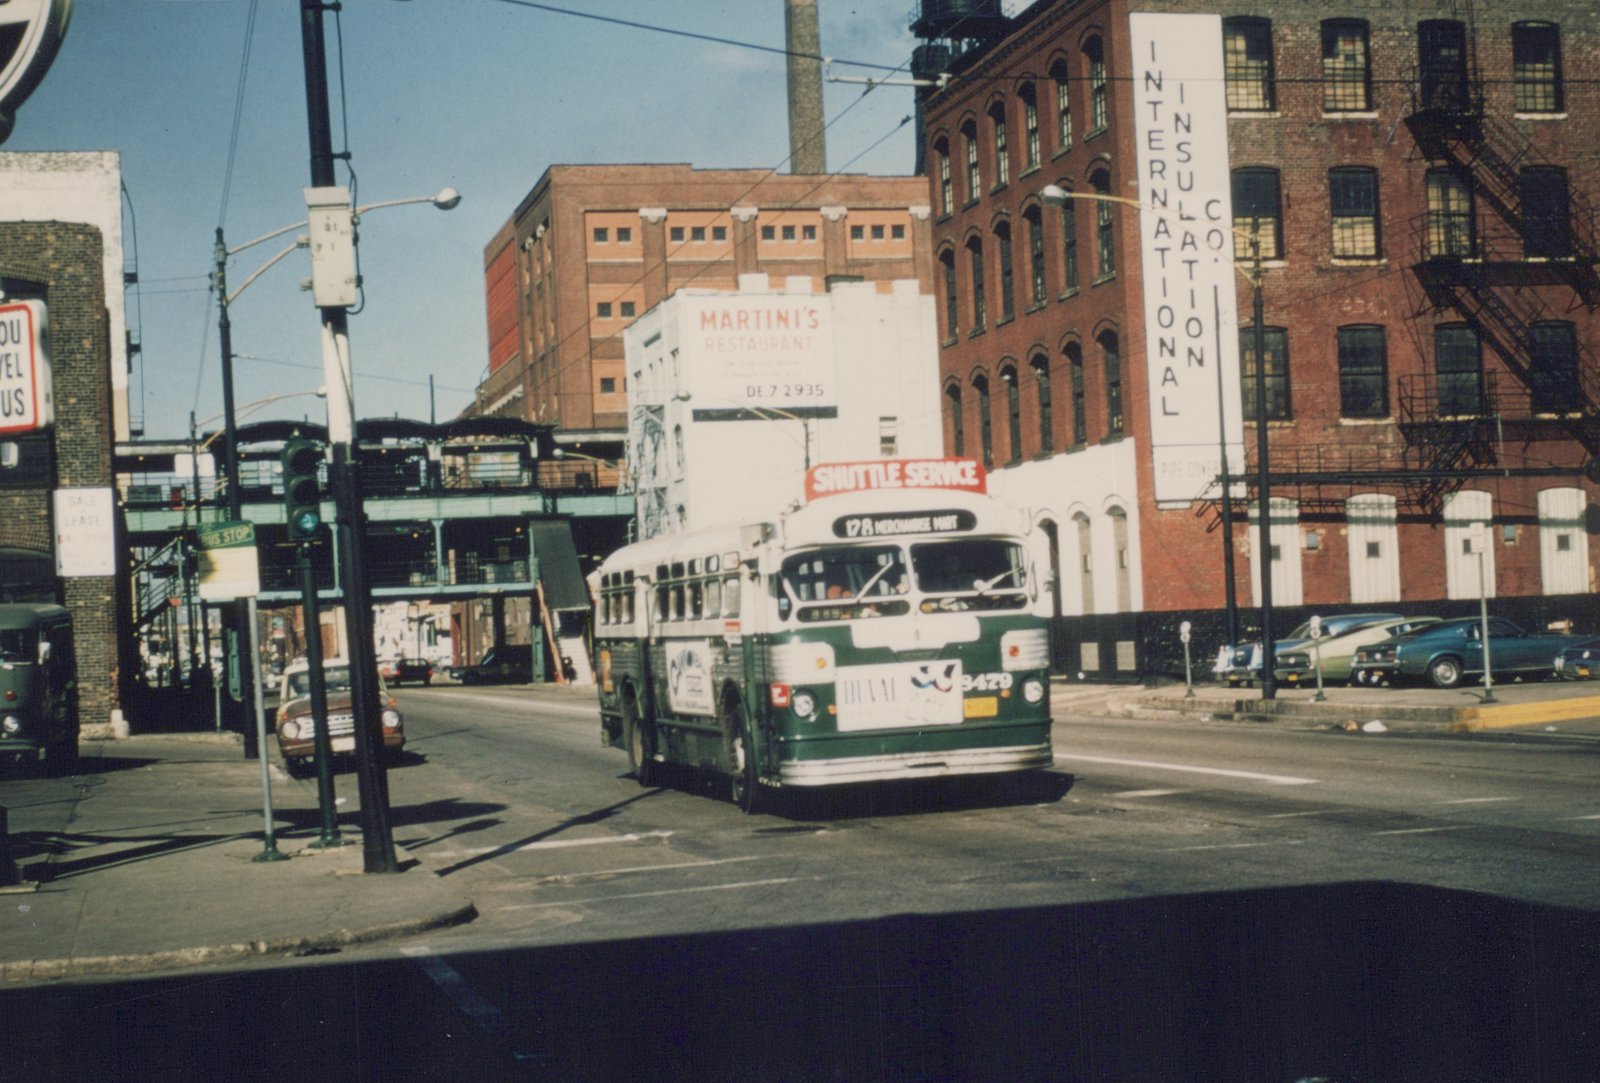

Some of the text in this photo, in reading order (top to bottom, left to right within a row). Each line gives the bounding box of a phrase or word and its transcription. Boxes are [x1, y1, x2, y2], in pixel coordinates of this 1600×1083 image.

[1145, 40, 1179, 416] INTERNATIONAL
[1174, 82, 1204, 367] INSULATION
[1205, 199, 1224, 263] CO.
[699, 305, 820, 331] MARTINI'S
[704, 336, 814, 352] RESTAURANT
[812, 461, 979, 492] SHUTTLE SERVICE
[68, 495, 96, 507] SALE
[64, 514, 101, 528] LEASE
[223, 526, 249, 543] STOP
